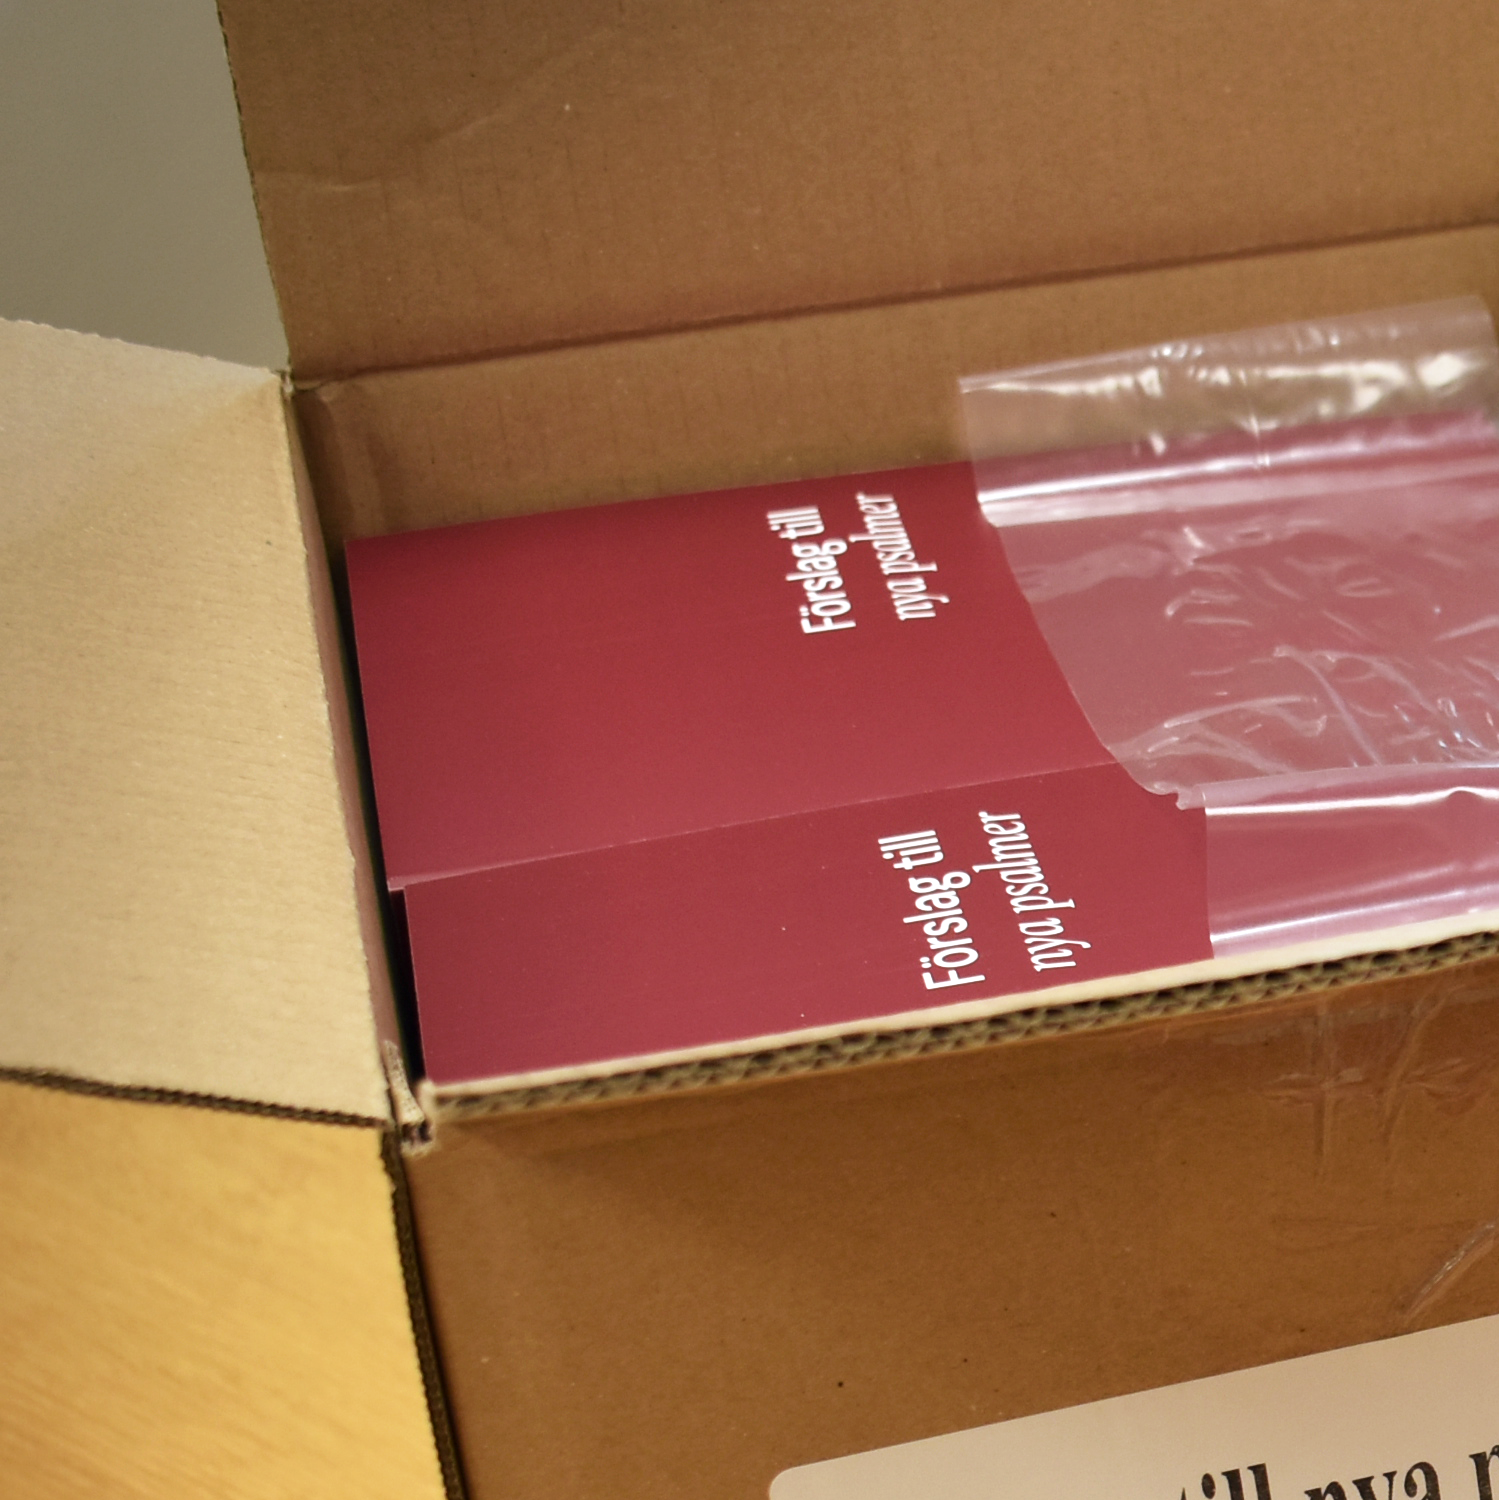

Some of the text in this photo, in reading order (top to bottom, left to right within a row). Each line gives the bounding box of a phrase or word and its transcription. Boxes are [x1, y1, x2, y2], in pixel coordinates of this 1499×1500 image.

[767, 506, 856, 634] Förslag till
[849, 491, 950, 621] nya psalmer
[878, 829, 986, 990] Förslag till
[971, 810, 1092, 973] nya psalmer
